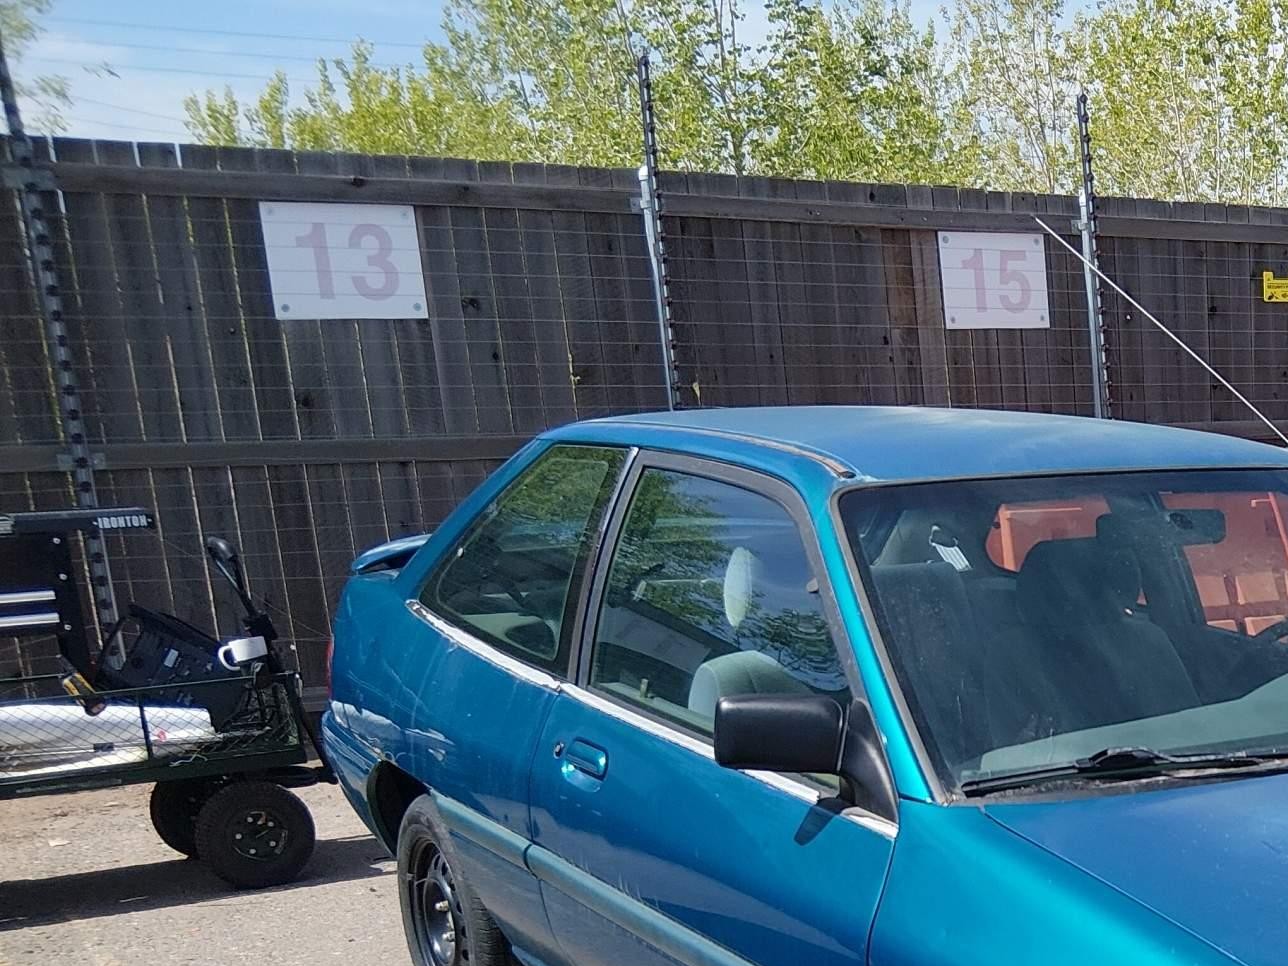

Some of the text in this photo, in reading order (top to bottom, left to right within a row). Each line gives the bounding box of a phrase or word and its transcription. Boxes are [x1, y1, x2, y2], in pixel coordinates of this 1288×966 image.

[295, 222, 400, 301] 13
[961, 248, 1032, 314] 15
[97, 515, 148, 529] IRONTON
